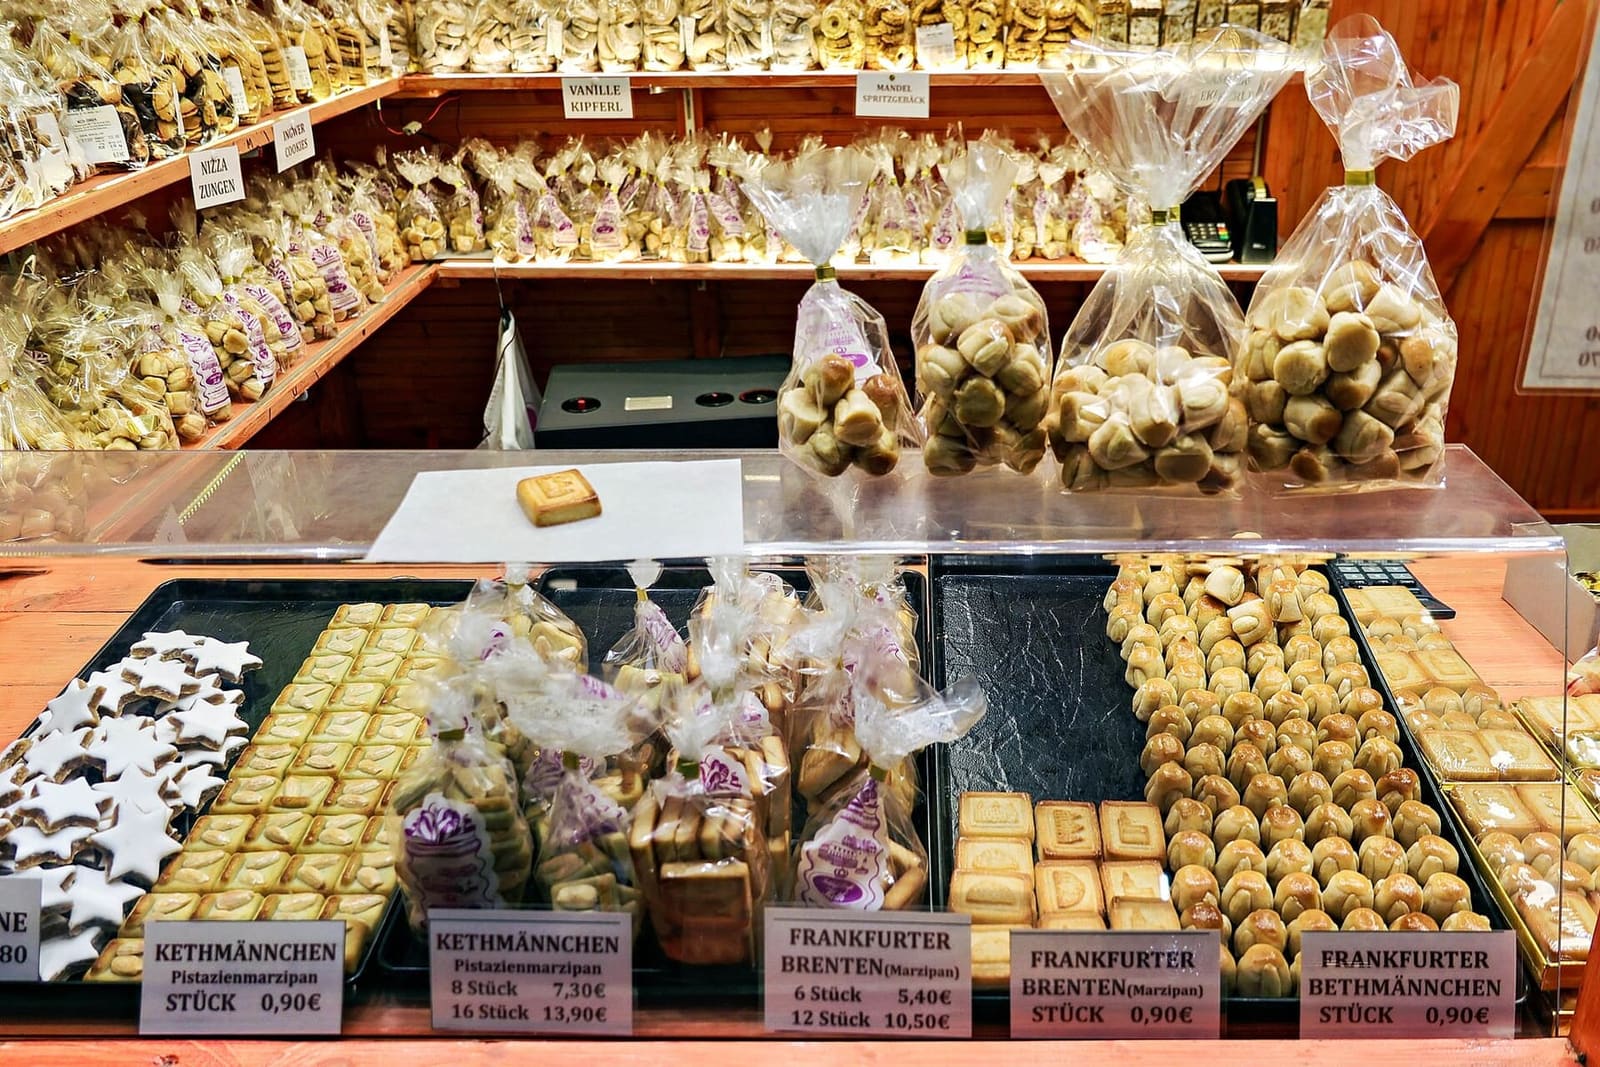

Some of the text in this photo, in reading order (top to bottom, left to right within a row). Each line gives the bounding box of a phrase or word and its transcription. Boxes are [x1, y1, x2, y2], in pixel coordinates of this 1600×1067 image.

[569, 85, 621, 96] VANILLE
[877, 84, 912, 92] MANDEL
[571, 101, 623, 112] KIPFERL
[863, 94, 925, 104] SPRITZGEBÄCK
[282, 123, 306, 141] INGWER
[284, 138, 309, 158] COOKIES
[200, 158, 228, 176] NIZZA
[199, 179, 236, 199] ZUNGEN
[0, 911, 27, 933] NE
[437, 931, 619, 954] KETHMÄNNCHEN
[790, 928, 951, 950] FRANKFURTER
[0, 944, 27, 964] 80
[155, 940, 337, 962] KETHMÄNNCHEN
[1031, 951, 1195, 969] FRANKFURTER
[1321, 951, 1490, 969] FRANKFURTER
[454, 958, 602, 977] Pistazienmarzipan
[171, 969, 318, 987] Pistazienmarzipan
[1309, 975, 1501, 997] BETHMÄNNCHEN
[451, 980, 606, 1000] 8 Stück 7,30€
[794, 985, 952, 1006] 6 Stück 5,40€
[166, 990, 321, 1014] STÜCK 0,90€
[452, 1004, 607, 1023] 16 Stück 13,90€
[792, 1010, 950, 1031] 12 Stück 10,50€
[1032, 1002, 1193, 1025] STÜCK 0,90€
[1319, 1003, 1490, 1026] STÜCK 0,90€
